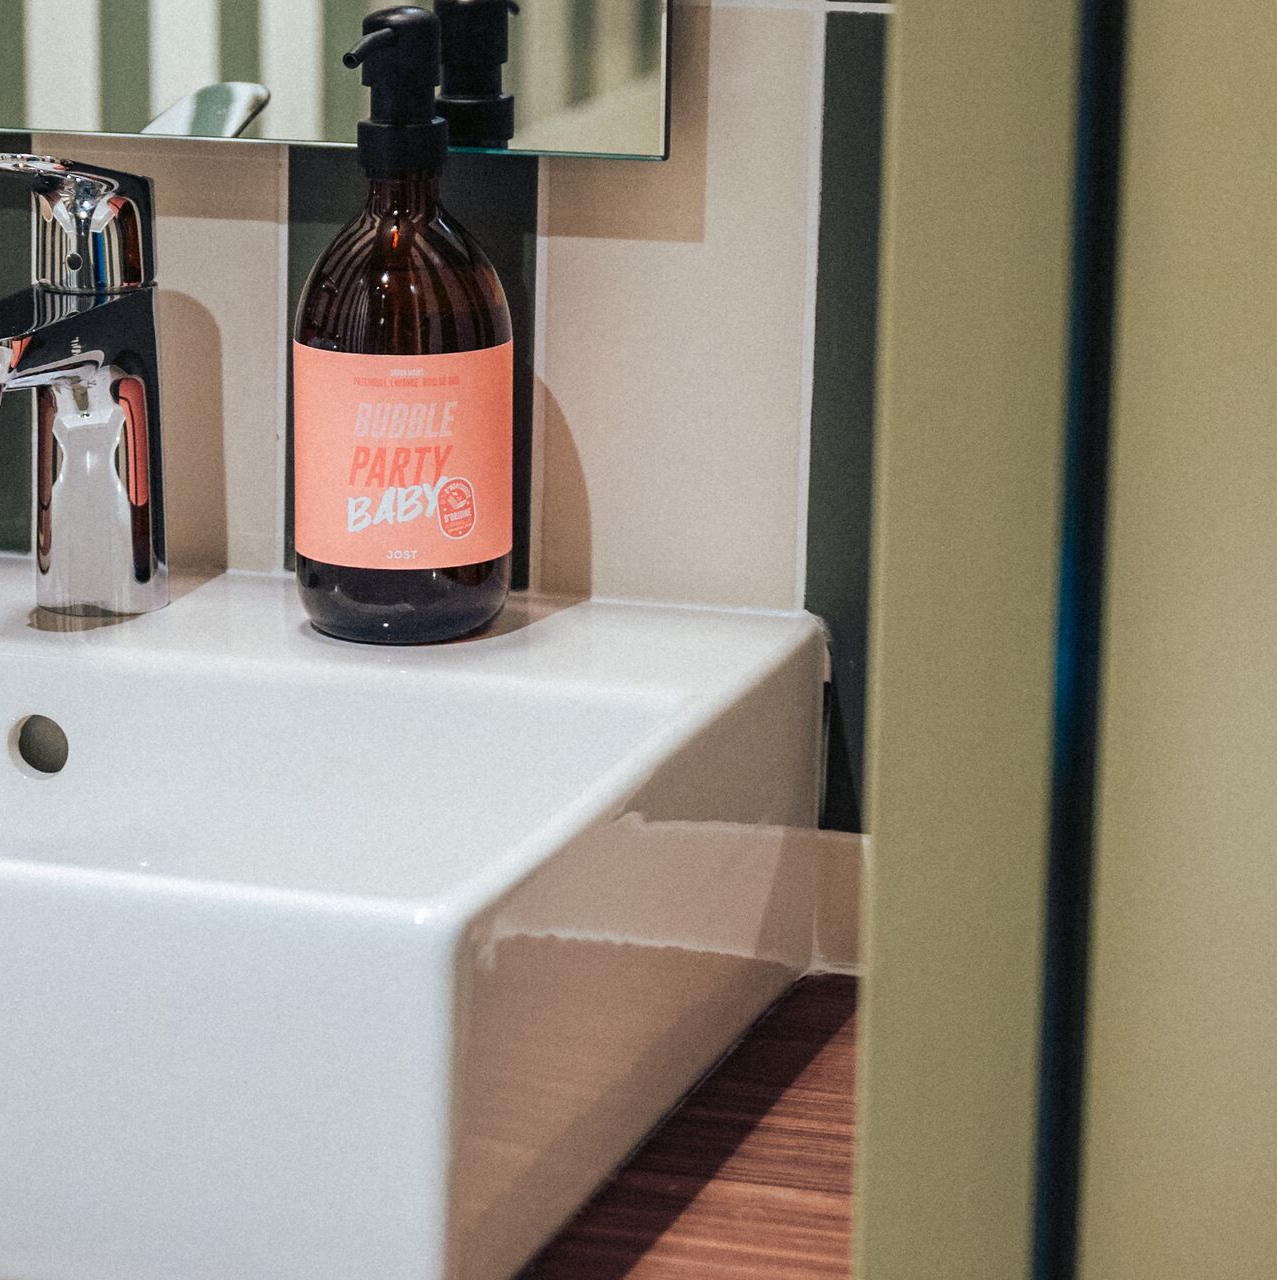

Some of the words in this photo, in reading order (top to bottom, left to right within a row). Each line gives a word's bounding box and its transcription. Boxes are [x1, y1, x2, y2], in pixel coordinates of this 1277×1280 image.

[354, 401, 458, 439] BUBBLE
[349, 445, 453, 489] PARTY
[347, 476, 448, 533] BABY
[387, 550, 418, 560] JOST
